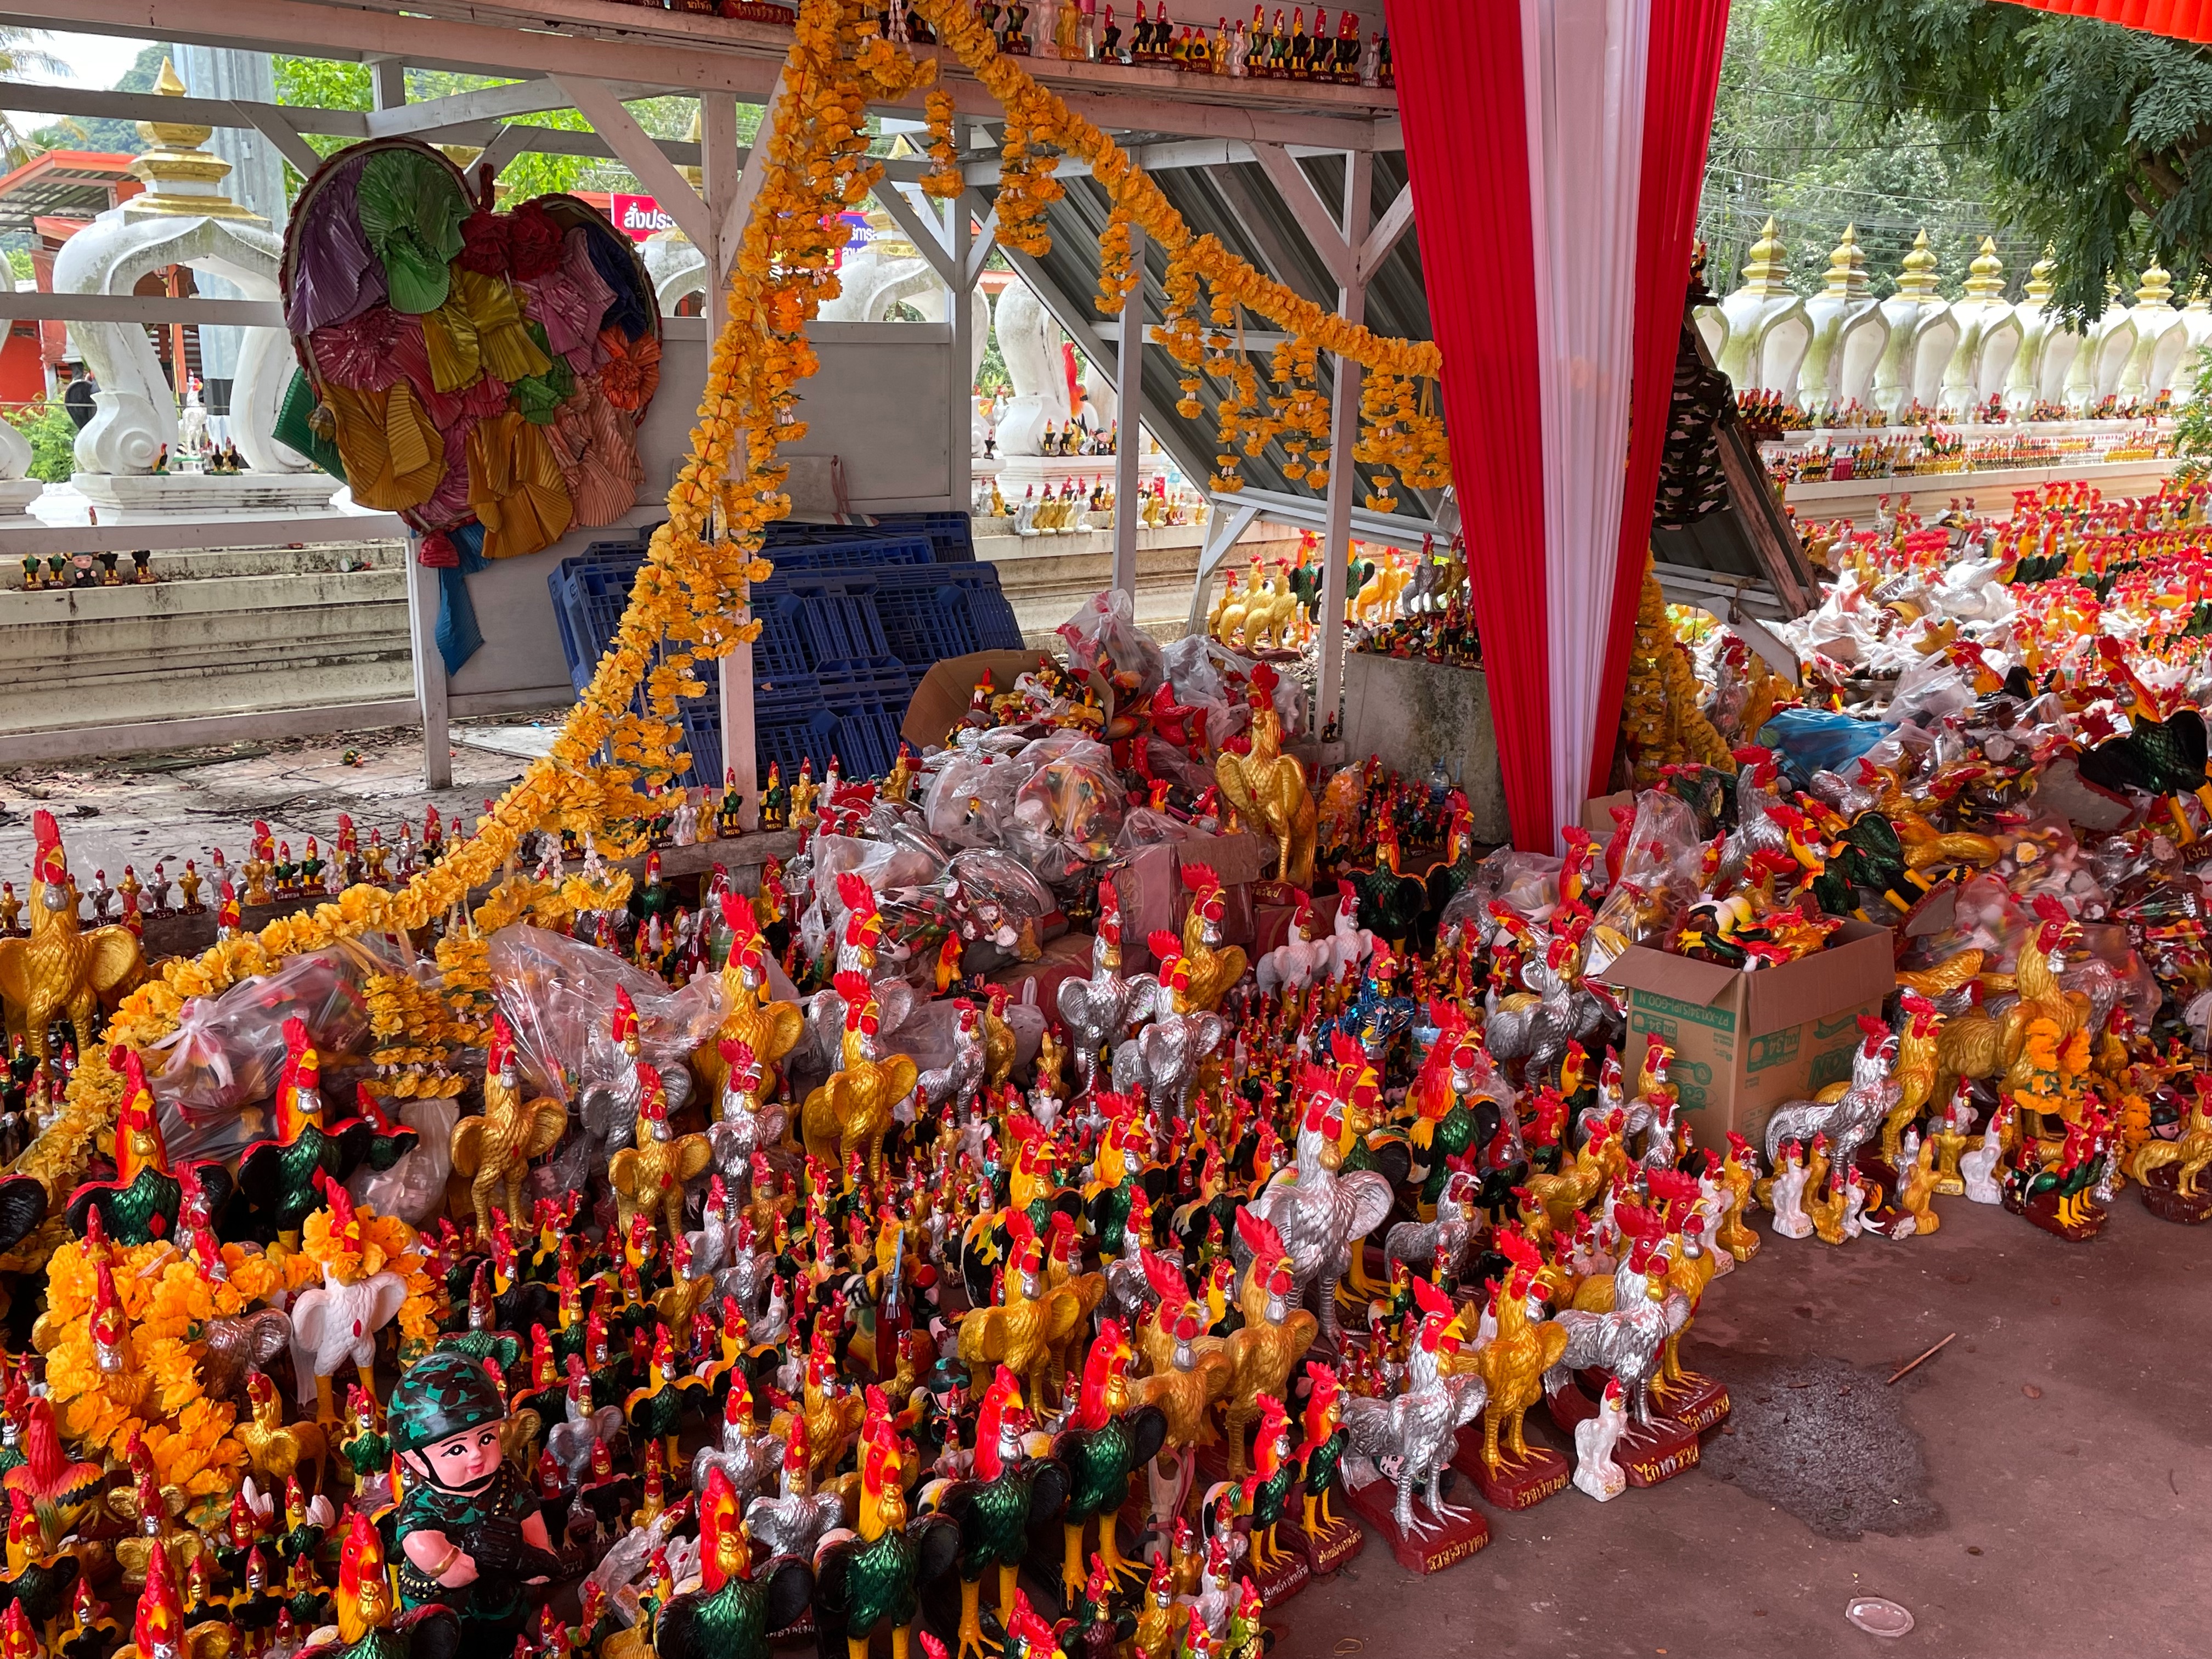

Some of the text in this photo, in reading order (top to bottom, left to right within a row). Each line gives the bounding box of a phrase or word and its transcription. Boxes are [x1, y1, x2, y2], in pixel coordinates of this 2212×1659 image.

[624, 201, 678, 230] สั่งประ
[1649, 1020, 1662, 1031] 34
[1768, 1039, 1782, 1056] 34
